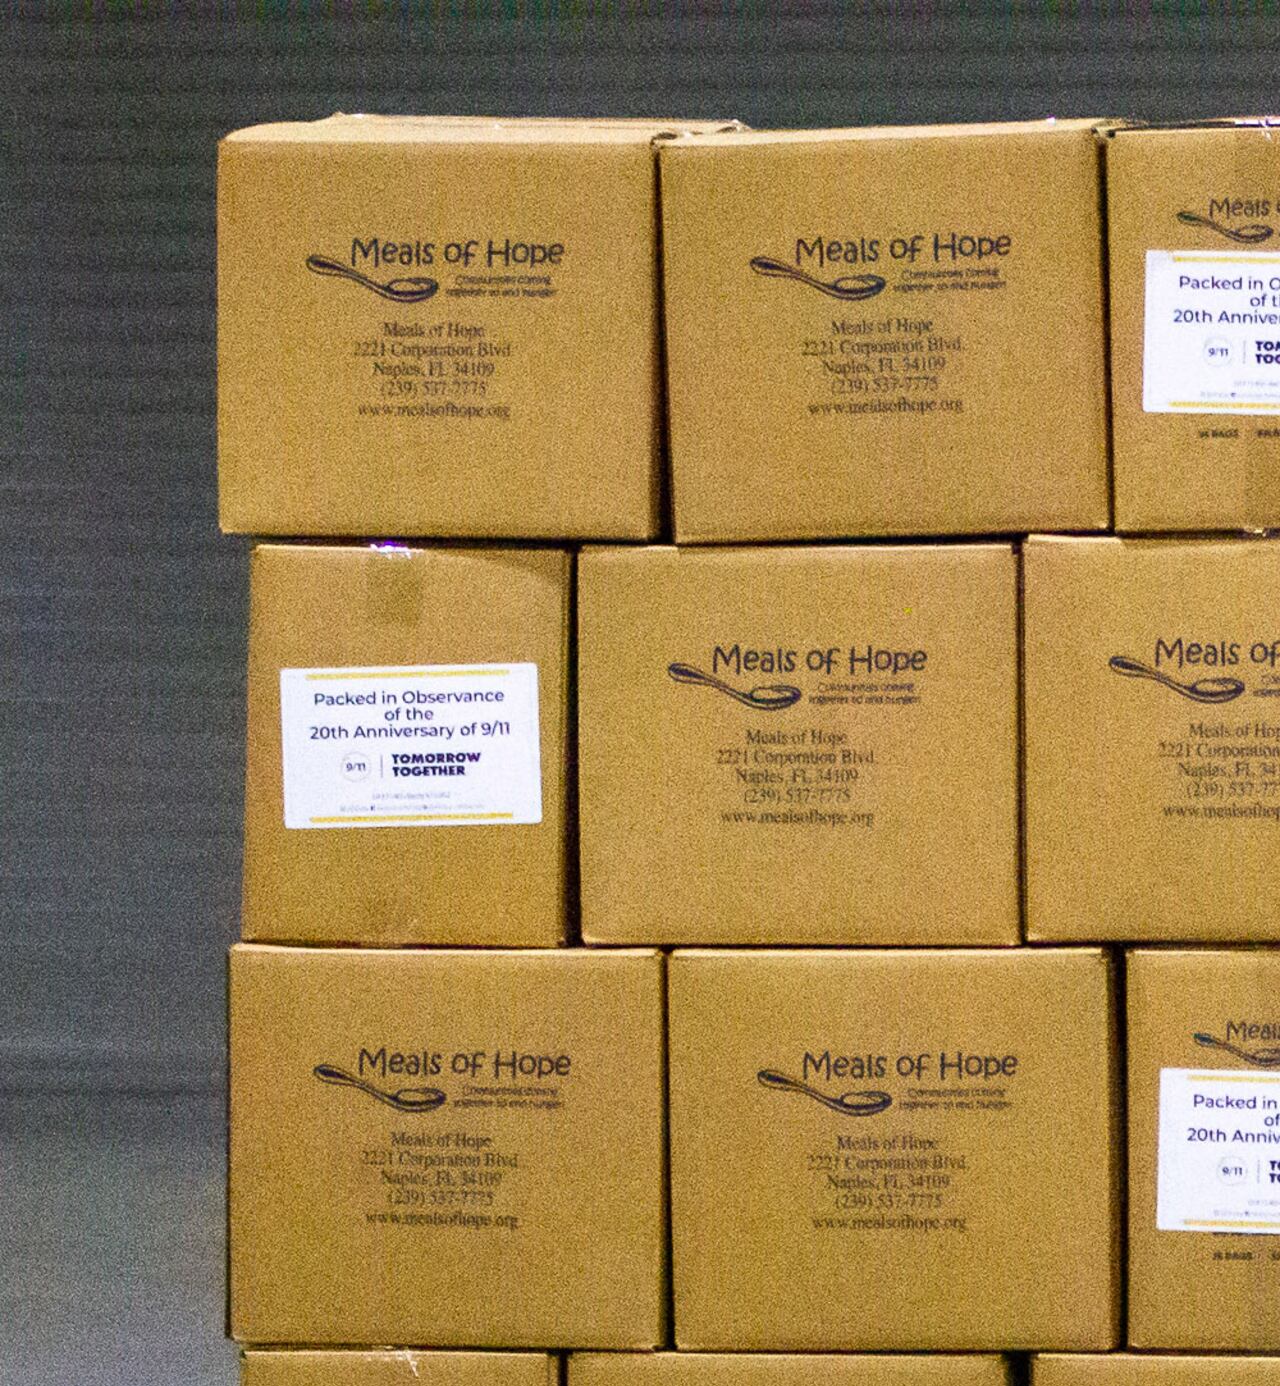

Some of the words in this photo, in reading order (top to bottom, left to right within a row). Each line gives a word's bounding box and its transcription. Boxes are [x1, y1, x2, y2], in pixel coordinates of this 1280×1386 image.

[1208, 197, 1272, 220] Meals
[350, 237, 436, 268] Meals
[443, 239, 480, 268] of
[486, 238, 565, 268] Hope
[795, 235, 881, 268] Meals
[889, 234, 925, 263] of
[932, 232, 1012, 263] Hope
[1178, 274, 1244, 291] Packed
[1247, 278, 1265, 291] in
[1249, 292, 1268, 308] of
[1173, 308, 1213, 324] 20th
[1207, 347, 1230, 357] 9/11
[712, 643, 798, 676] Meals
[805, 647, 841, 676] of
[848, 644, 928, 676] Hope
[1154, 637, 1241, 669] Meals
[313, 691, 377, 707] Packed
[381, 690, 398, 705] in
[401, 690, 505, 705] Observance
[383, 707, 401, 722] of
[405, 707, 435, 721] the
[309, 725, 350, 741] 20th
[352, 724, 455, 740] Anniversary
[459, 721, 477, 737] of
[480, 720, 511, 737] 9/11
[345, 762, 367, 772] 9/11
[391, 752, 481, 765] TOMORROW
[392, 765, 466, 777] TOGETHER
[358, 1046, 442, 1078] Meals
[450, 1050, 487, 1079] of
[493, 1050, 572, 1080] Hope
[802, 1050, 888, 1082] Meals
[895, 1053, 932, 1081] of
[939, 1051, 1019, 1081] Hope
[1192, 1093, 1258, 1110] Packed
[1261, 1098, 1279, 1110] in
[1186, 1126, 1228, 1142] 20th
[1221, 1166, 1244, 1176] 9/11
